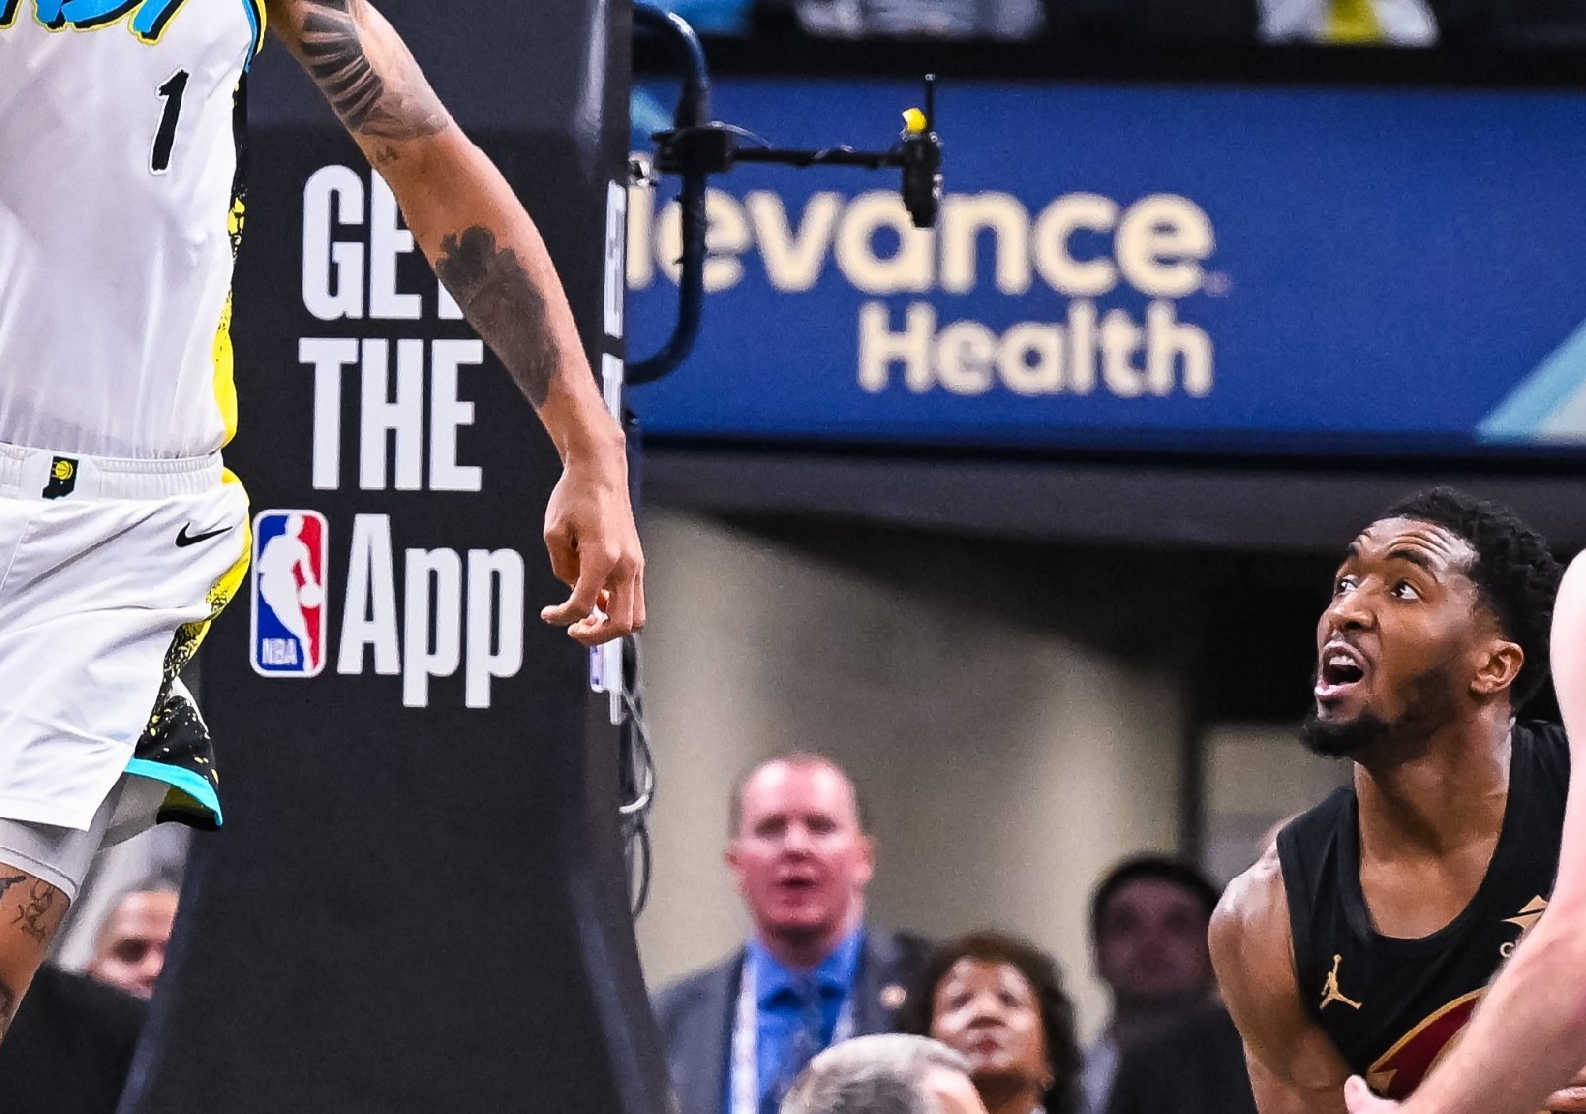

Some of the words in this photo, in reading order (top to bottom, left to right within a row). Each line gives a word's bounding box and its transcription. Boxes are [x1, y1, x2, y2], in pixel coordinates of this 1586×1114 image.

[151, 68, 190, 172] 1
[301, 164, 464, 321] GE
[858, 298, 1213, 396] Health
[298, 337, 484, 492] THE
[261, 637, 298, 666] NBA
[336, 513, 525, 709] App
